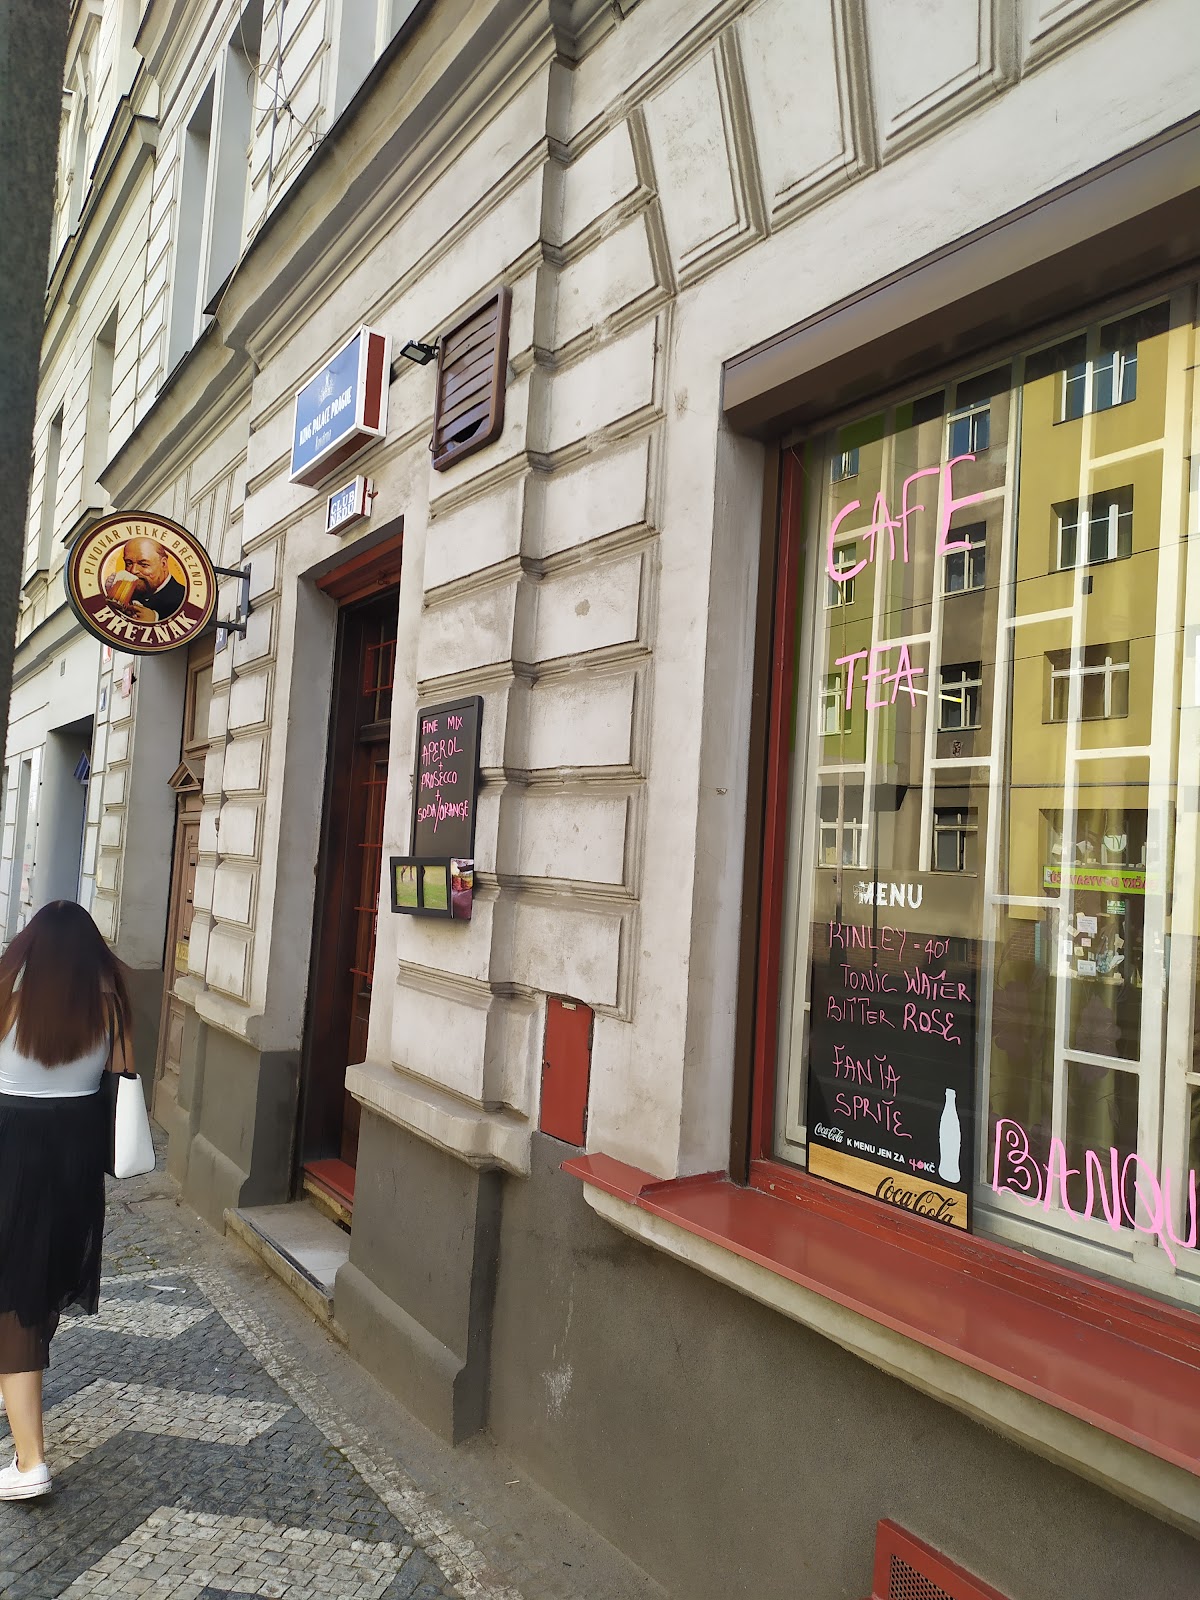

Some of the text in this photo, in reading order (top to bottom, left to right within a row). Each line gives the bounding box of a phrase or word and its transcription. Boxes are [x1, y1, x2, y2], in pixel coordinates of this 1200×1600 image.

[312, 405, 331, 435] PALACE
[331, 386, 353, 419] PRAGUE
[331, 490, 355, 514] CLUB
[827, 454, 985, 581] CAFE
[84, 525, 203, 586] PIVOVAR VELKÉ BŘEZNO
[93, 605, 198, 644] BŘEZŇÁK
[835, 643, 925, 710] TEA
[422, 715, 463, 735] FINE MIX
[421, 737, 463, 766] APEROL
[420, 770, 458, 792] PROSECCO
[856, 880, 923, 909] MENU
[829, 919, 907, 962] KINLEY
[839, 961, 972, 1003] TONIC WATER
[827, 995, 961, 1045] BITTER ROSE
[833, 1092, 913, 1139] SPRITE
[846, 1138, 853, 1147] K
[853, 1141, 876, 1154] MENU
[876, 1147, 892, 1159] JEN
[893, 1152, 906, 1164] ZA
[992, 1118, 1197, 1267] BANQU
